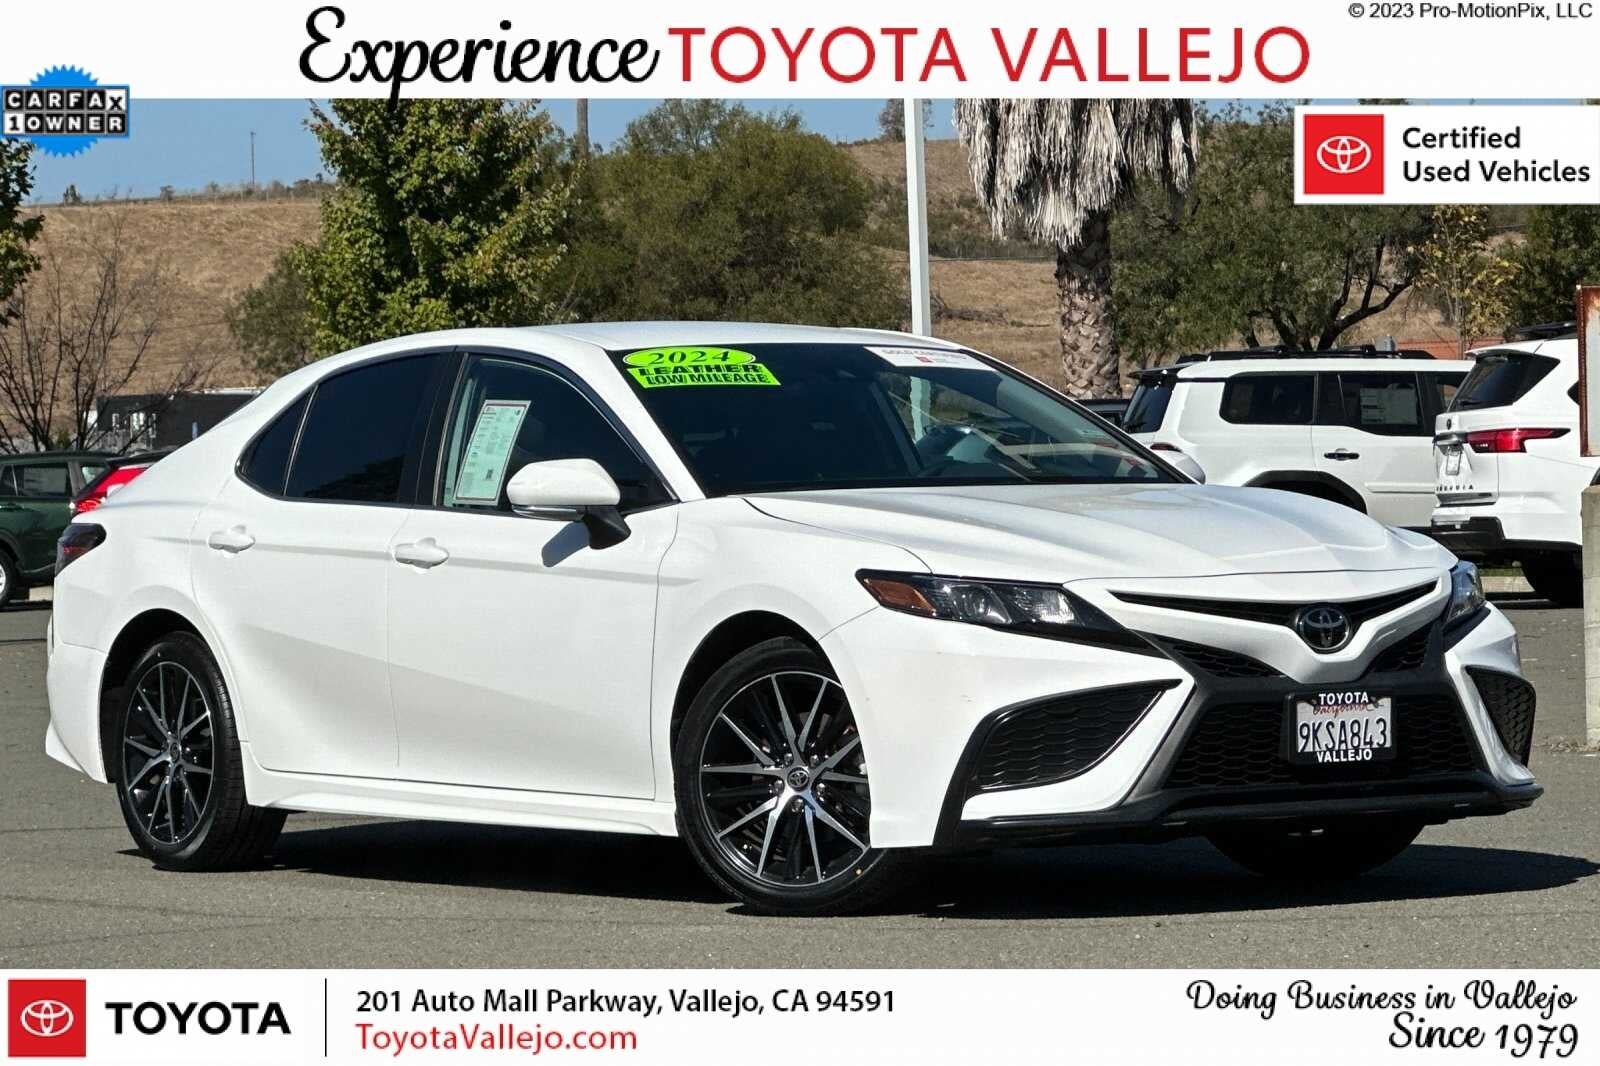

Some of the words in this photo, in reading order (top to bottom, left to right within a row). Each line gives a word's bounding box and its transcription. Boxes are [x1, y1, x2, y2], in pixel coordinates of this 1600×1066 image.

[648, 351, 731, 365] 2024
[638, 364, 762, 376] LEATHER
[647, 374, 687, 385] LOW
[688, 373, 771, 384] MILEAGE
[1319, 692, 1368, 705] TOYOTA
[1299, 718, 1387, 752] 9KSA843
[1317, 749, 1372, 763] VALLEJO
